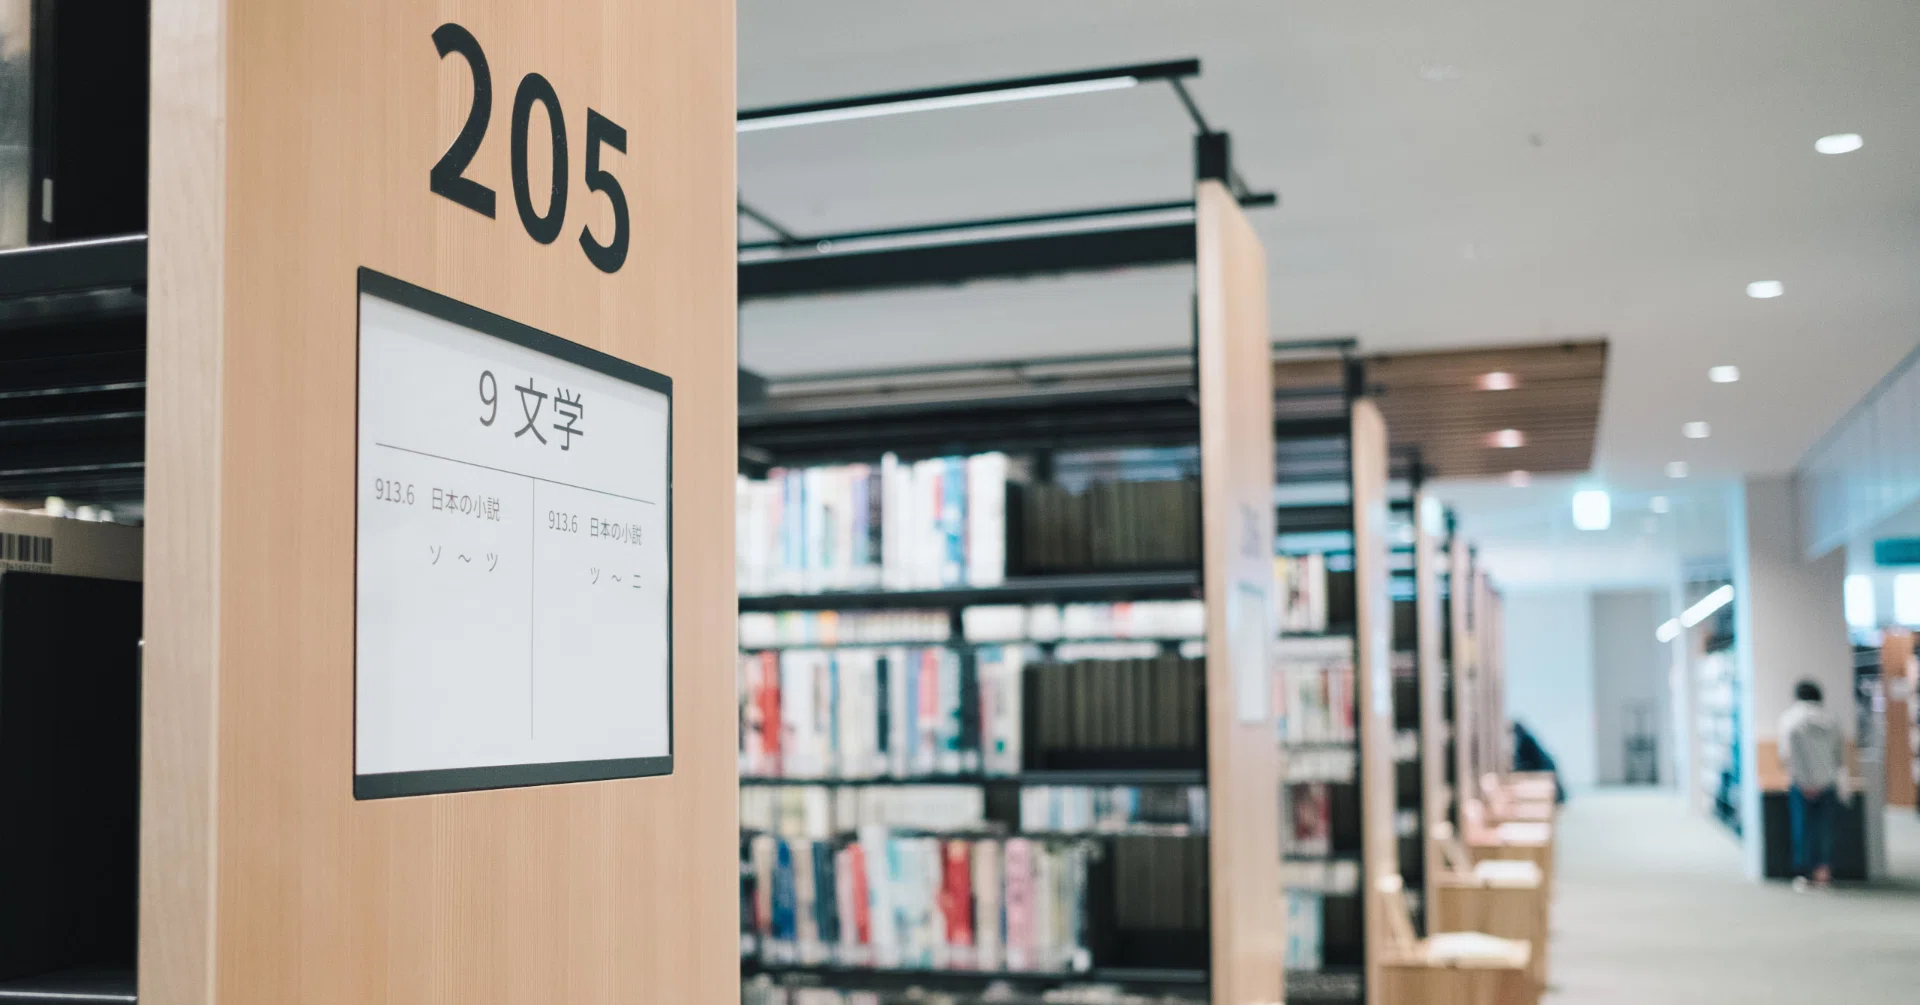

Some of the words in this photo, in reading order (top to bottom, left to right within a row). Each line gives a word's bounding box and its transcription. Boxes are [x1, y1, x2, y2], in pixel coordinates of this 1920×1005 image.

[430, 23, 630, 274] 205
[478, 369, 498, 427] 9
[513, 377, 584, 452] 文学
[375, 478, 415, 506] 913.6
[431, 487, 500, 522] 日本の小説
[548, 510, 578, 534] 913.6
[590, 517, 642, 546] 日本の小説
[429, 545, 442, 565] ソ
[486, 552, 498, 572] ツ
